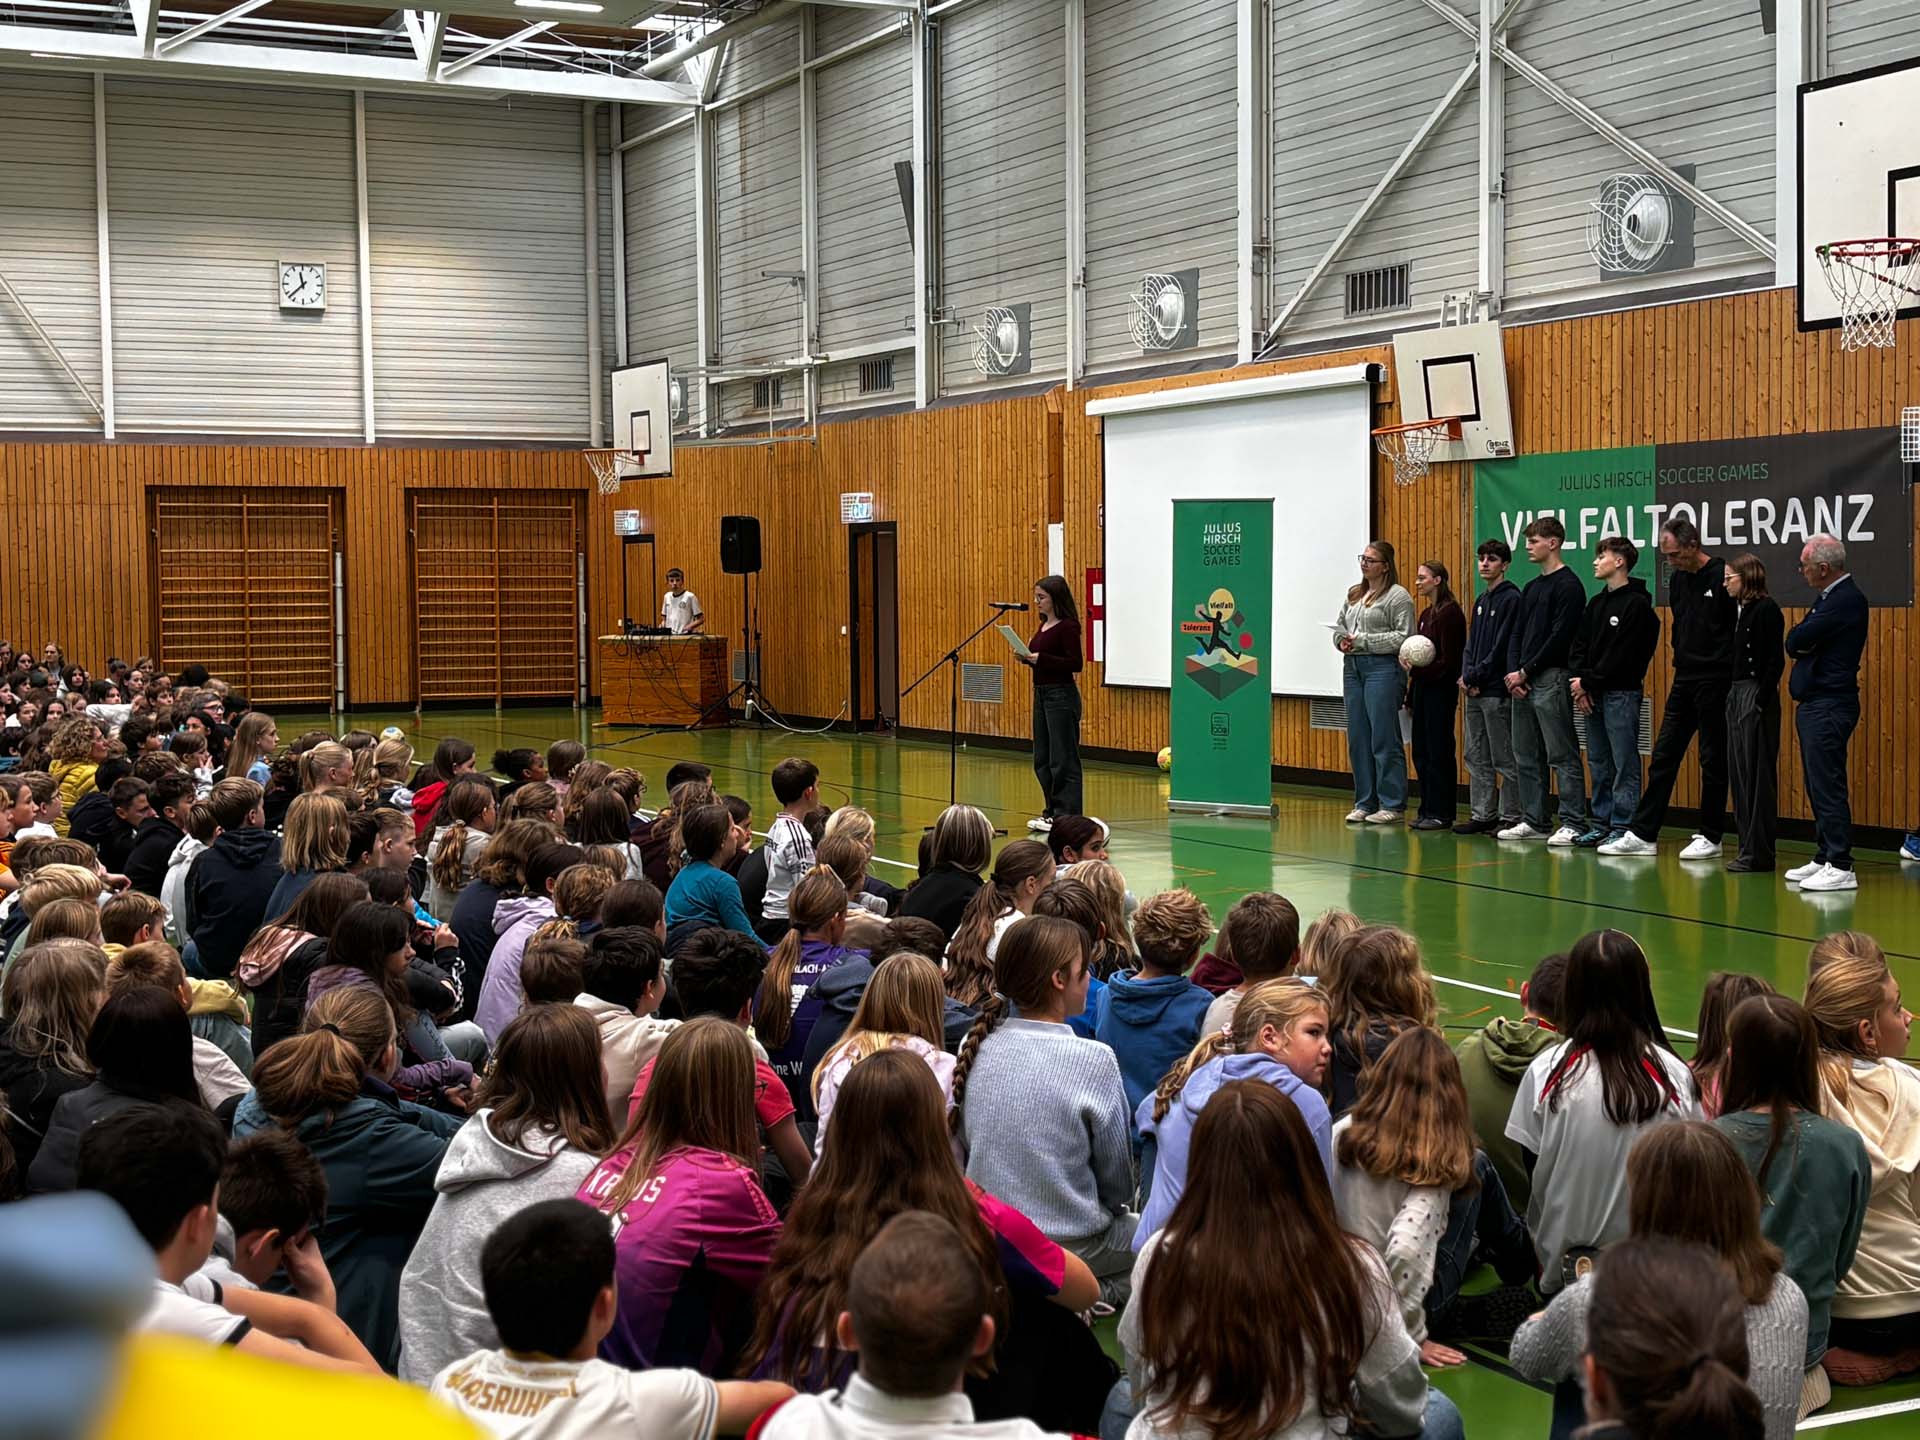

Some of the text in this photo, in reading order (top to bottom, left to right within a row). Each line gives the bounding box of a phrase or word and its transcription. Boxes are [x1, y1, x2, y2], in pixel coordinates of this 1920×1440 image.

[1559, 462, 1769, 492] JULIUS HIRSCH SOCCER GAMES
[1203, 522, 1241, 533] JULIUS
[1500, 493, 1875, 552] VLFALTOLERANZ
[1203, 534, 1241, 544] HIRSCH
[1203, 545, 1241, 555] SOCCER
[1203, 556, 1241, 566] GAMES
[585, 1168, 667, 1203] KRUS
